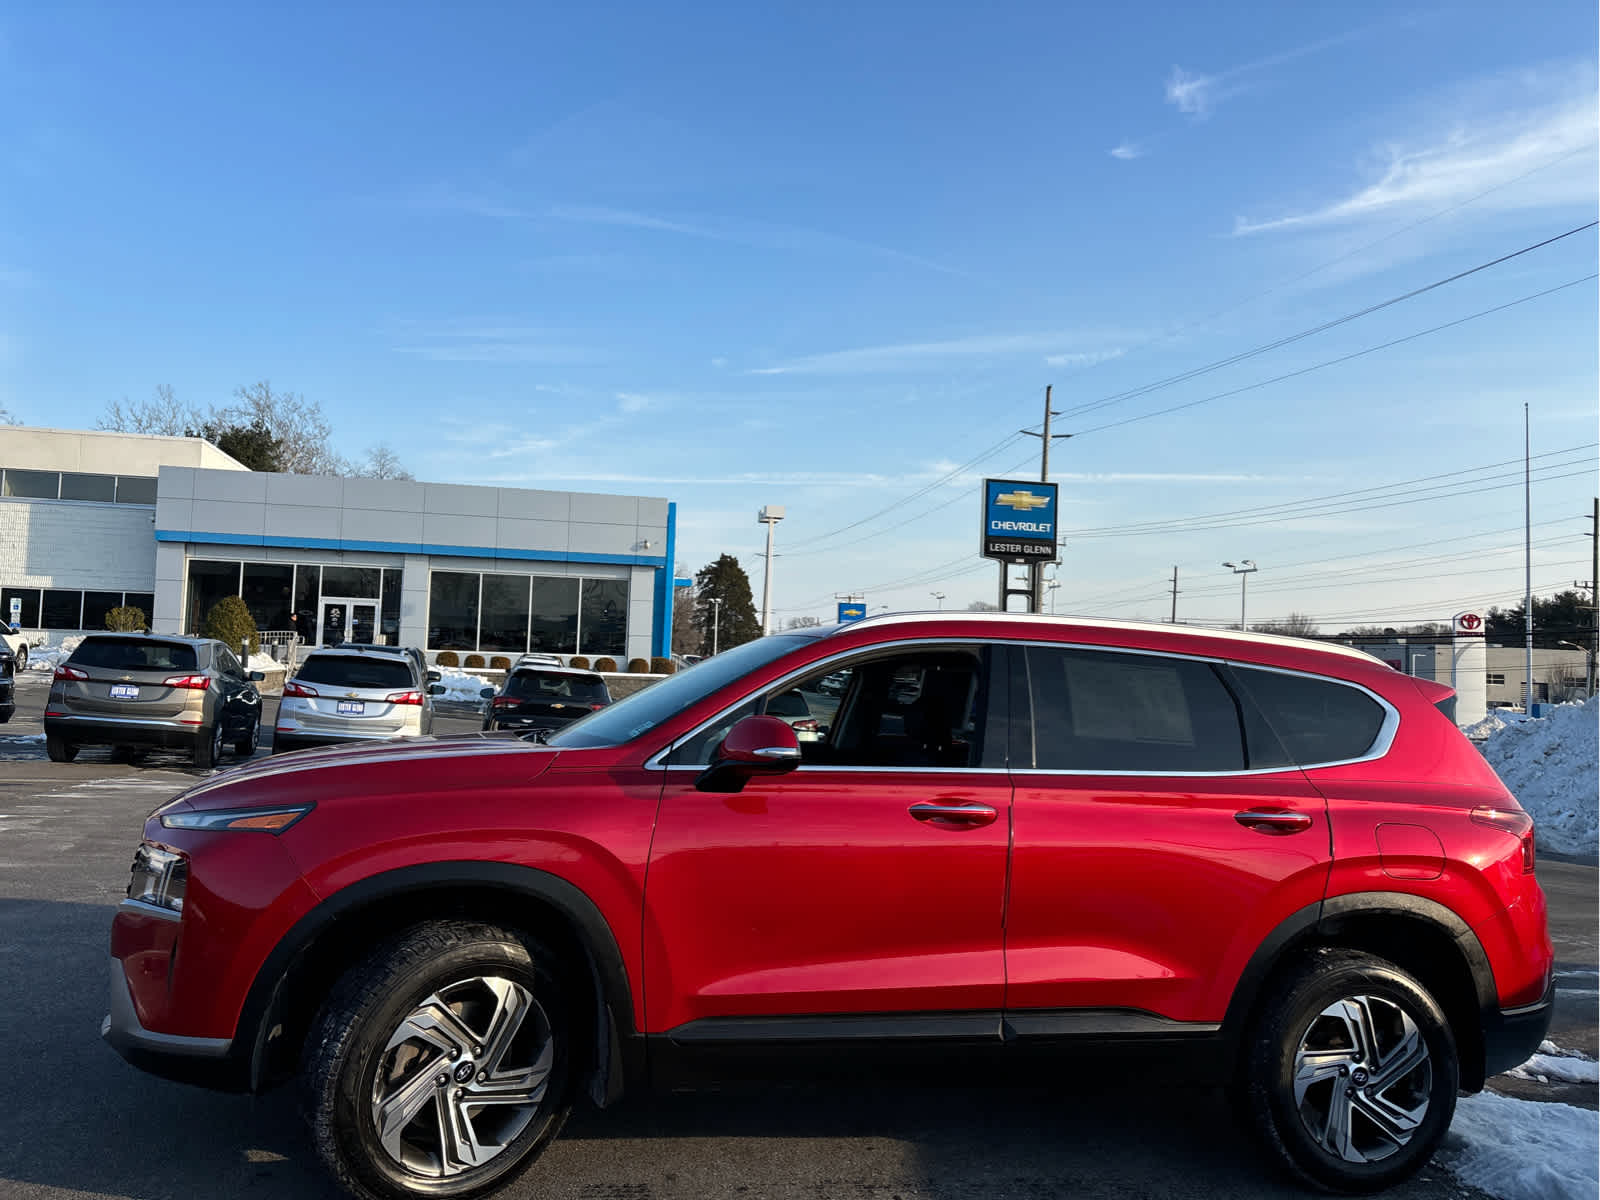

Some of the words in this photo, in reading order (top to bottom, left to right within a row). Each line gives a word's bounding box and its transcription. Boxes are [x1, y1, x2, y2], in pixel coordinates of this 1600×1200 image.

[991, 520, 1051, 533] CHEVROLET
[990, 543, 1021, 553] LESTER
[1023, 545, 1052, 554] GLENN
